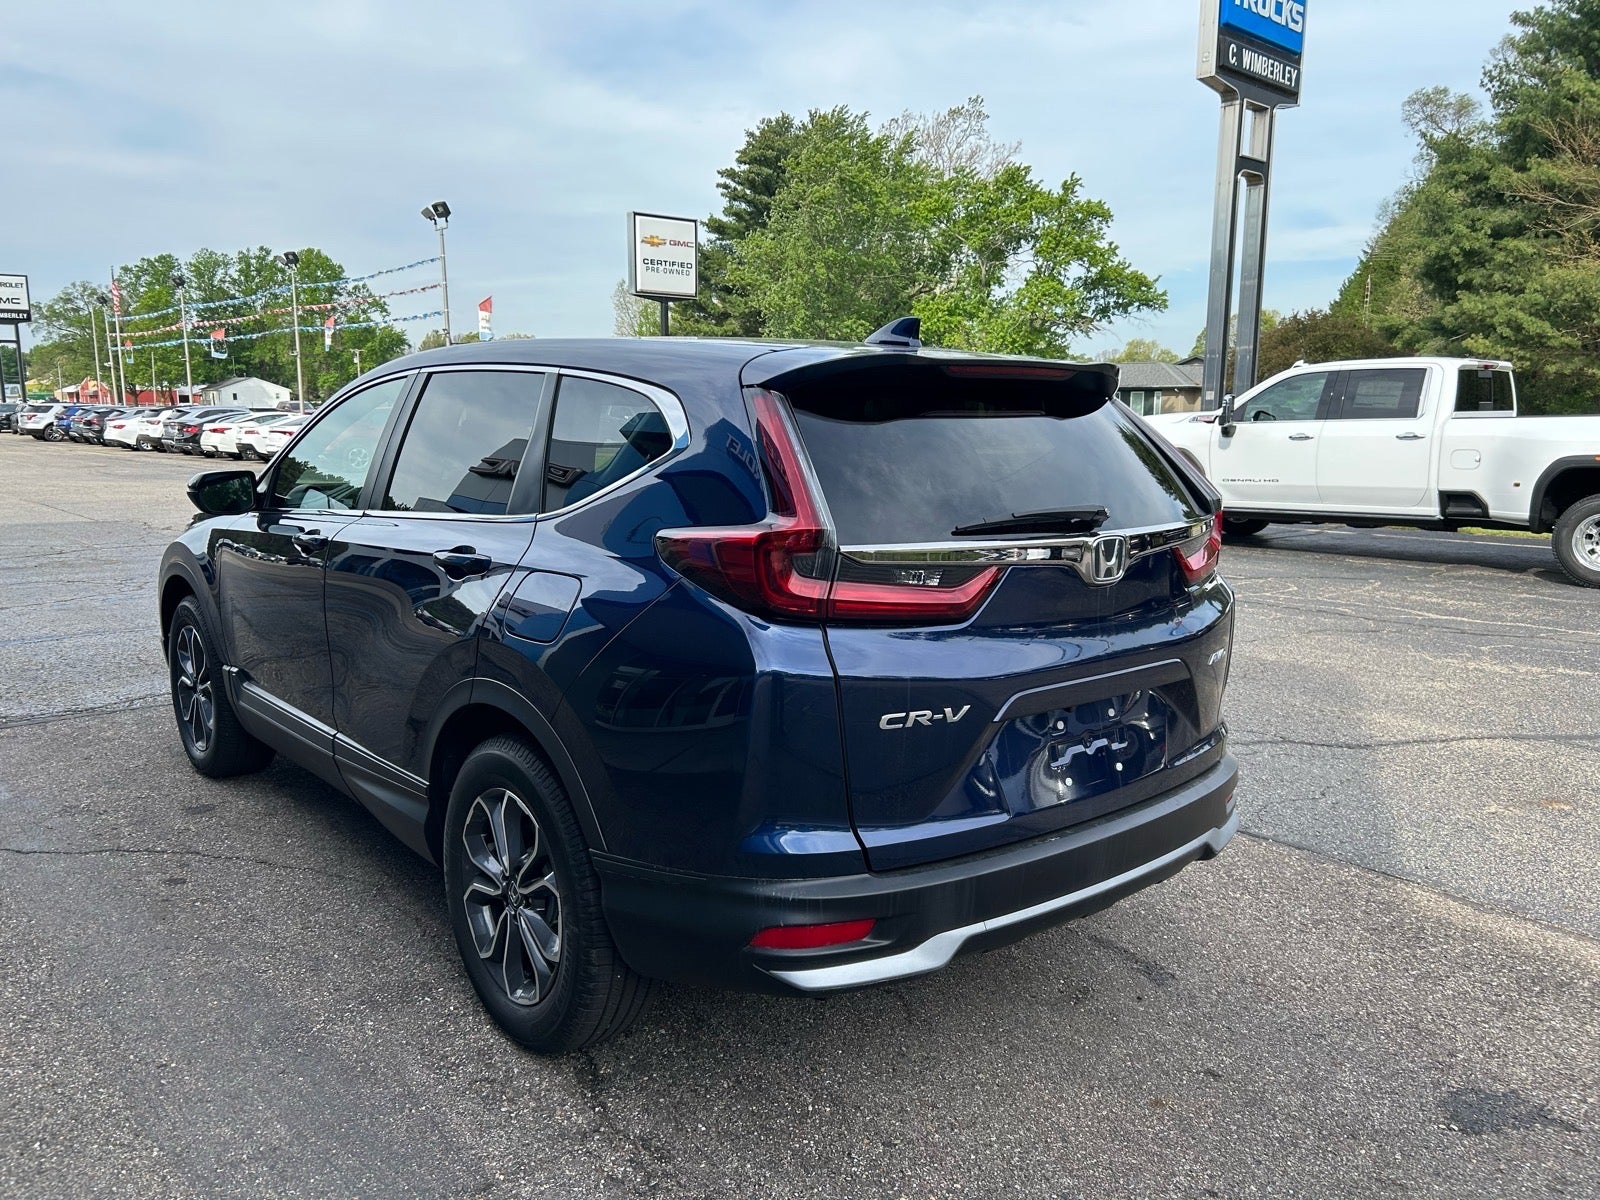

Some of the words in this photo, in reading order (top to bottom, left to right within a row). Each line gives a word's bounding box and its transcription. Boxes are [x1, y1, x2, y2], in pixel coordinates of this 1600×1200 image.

[1235, 0, 1304, 33] UCKS
[1228, 43, 1238, 66] C.
[1242, 48, 1298, 88] WIMBERLEY
[669, 239, 695, 248] GMC
[642, 258, 693, 269] CERTIFIED
[645, 265, 691, 277] PRE-OWNED
[879, 704, 972, 730] CR-V
